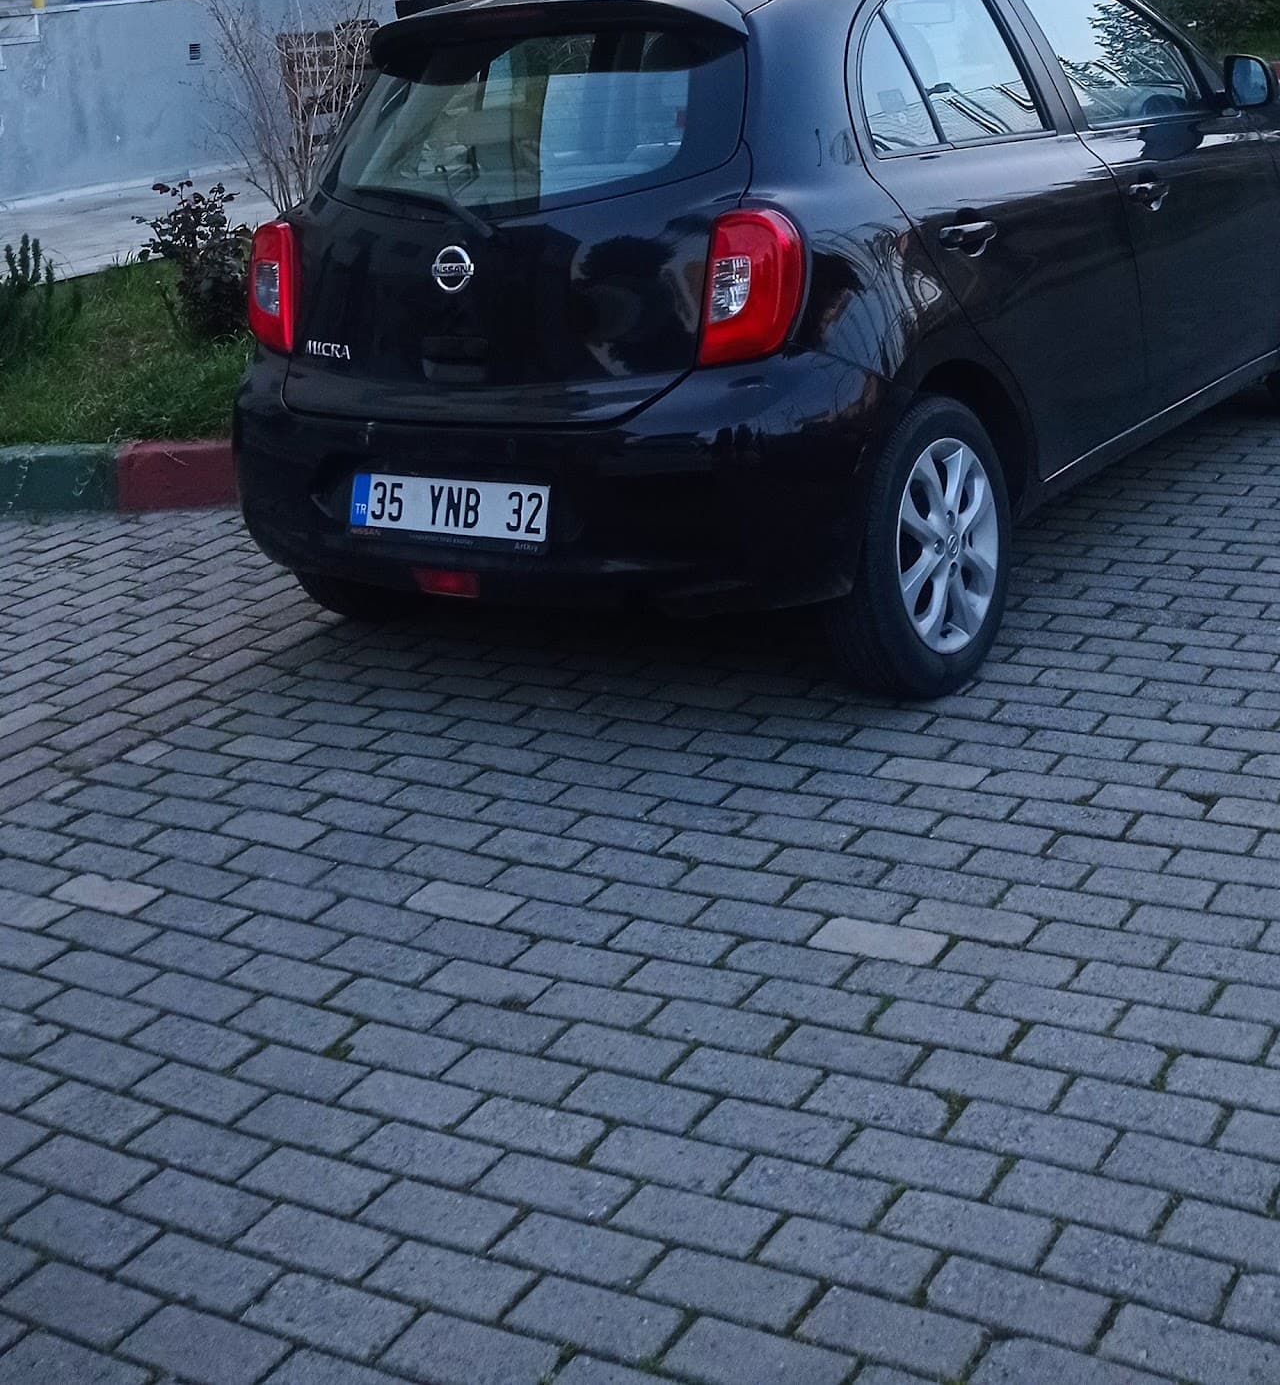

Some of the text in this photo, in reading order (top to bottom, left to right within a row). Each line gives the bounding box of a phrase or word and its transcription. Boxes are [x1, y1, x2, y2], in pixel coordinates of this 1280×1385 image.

[432, 264, 474, 275] NISSAN
[306, 339, 350, 360] MICRA
[355, 481, 544, 535] TR 35 YNB 32
